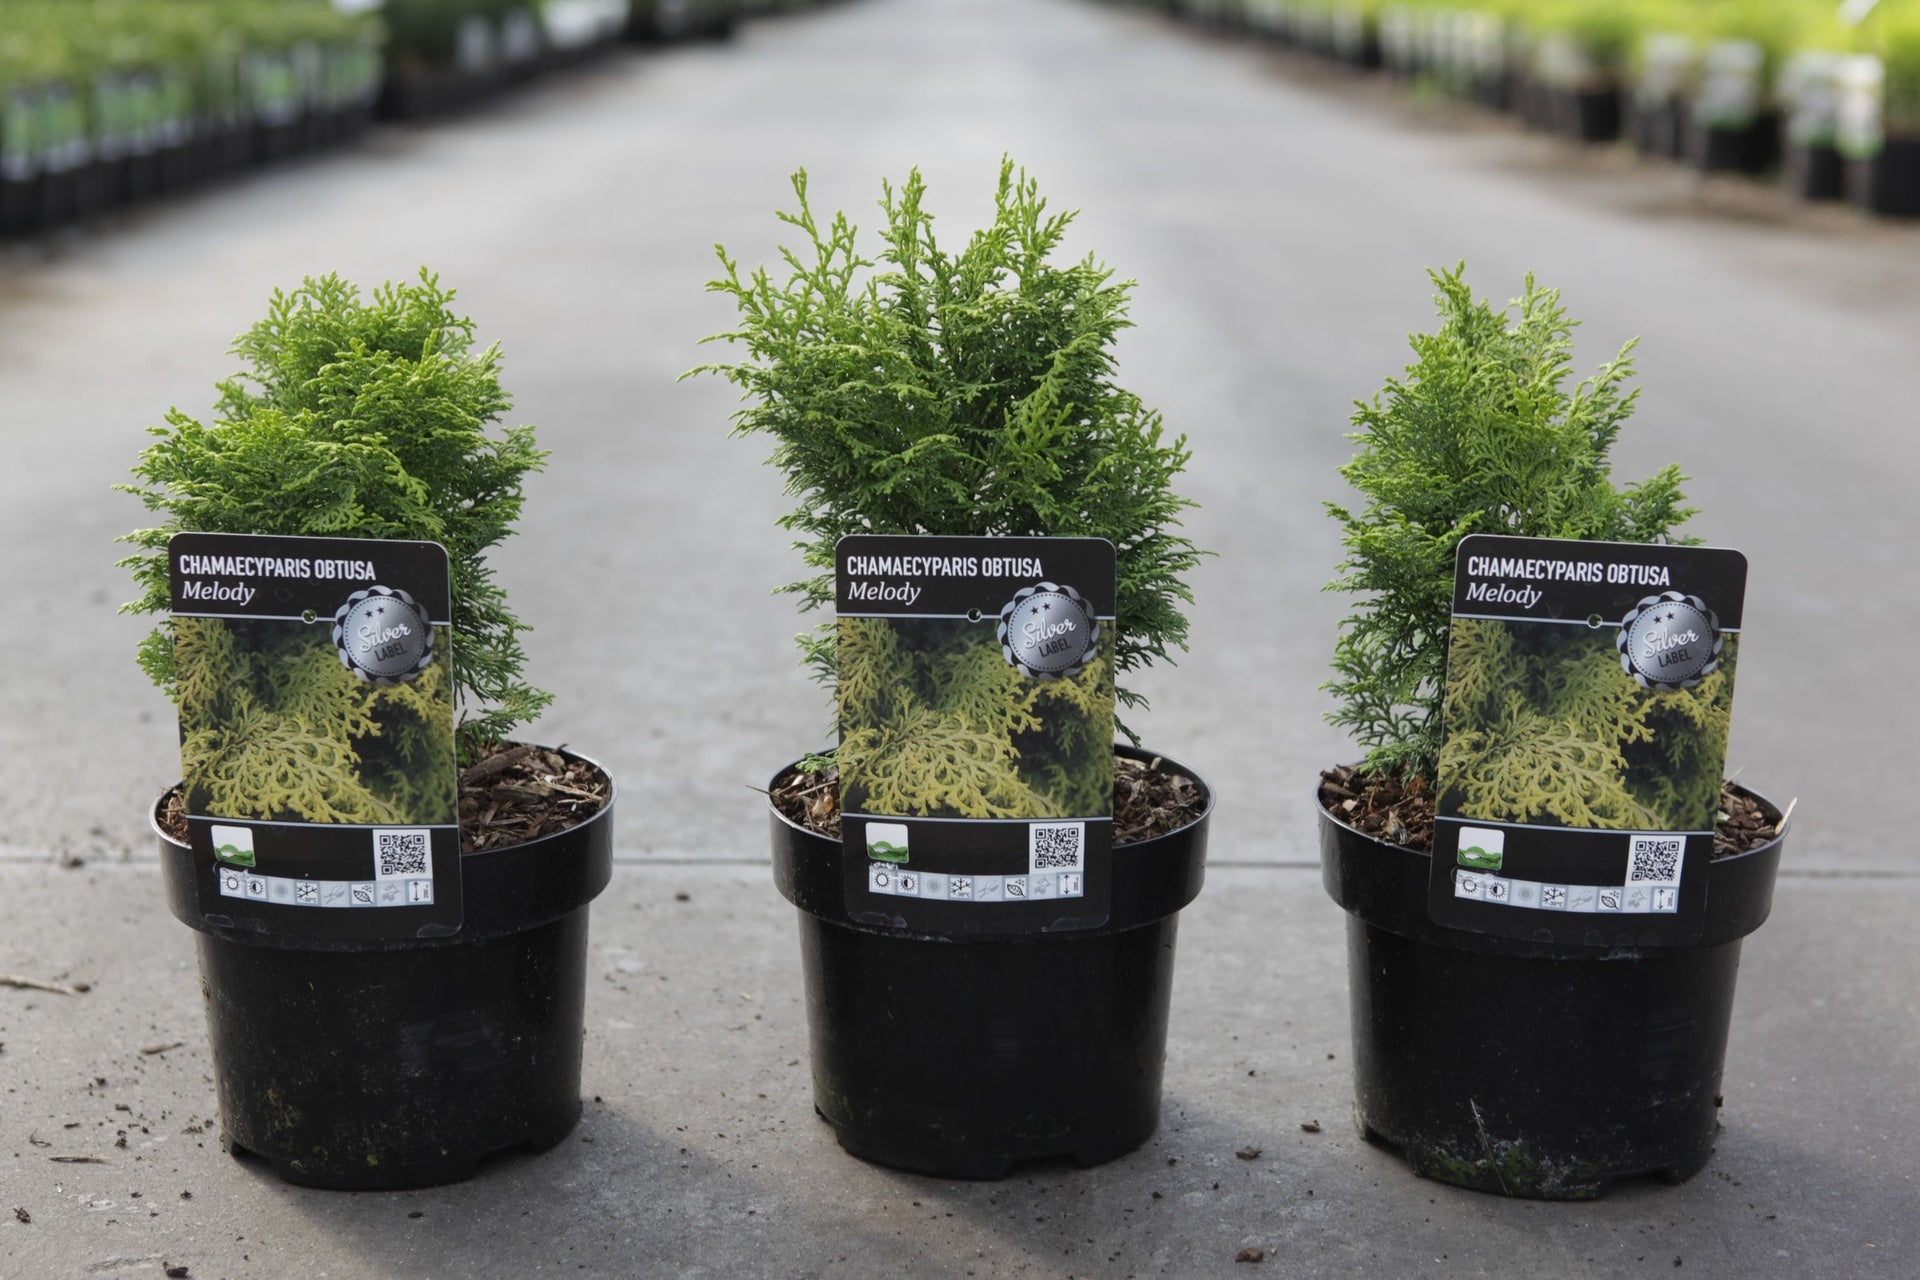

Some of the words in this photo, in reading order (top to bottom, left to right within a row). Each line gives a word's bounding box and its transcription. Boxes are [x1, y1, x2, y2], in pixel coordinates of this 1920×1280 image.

[179, 554, 311, 579] CHAMAECYPARIS
[313, 558, 376, 581] OBTUSA
[846, 555, 978, 578] CHAMAECYPARIS
[981, 557, 1044, 578] OBTUSA
[1467, 555, 1603, 583] CHAMAECYPARIS
[1606, 563, 1671, 587] OBTUSA
[181, 580, 256, 606] Melody
[847, 581, 922, 606] Melody
[1465, 581, 1543, 610] Melody
[357, 621, 412, 653] Silver
[1022, 617, 1077, 649] Silver
[1641, 626, 1699, 659] Silver
[374, 642, 408, 662] LABEL
[1038, 637, 1072, 658] LABEL
[1657, 648, 1693, 668] LABEL
